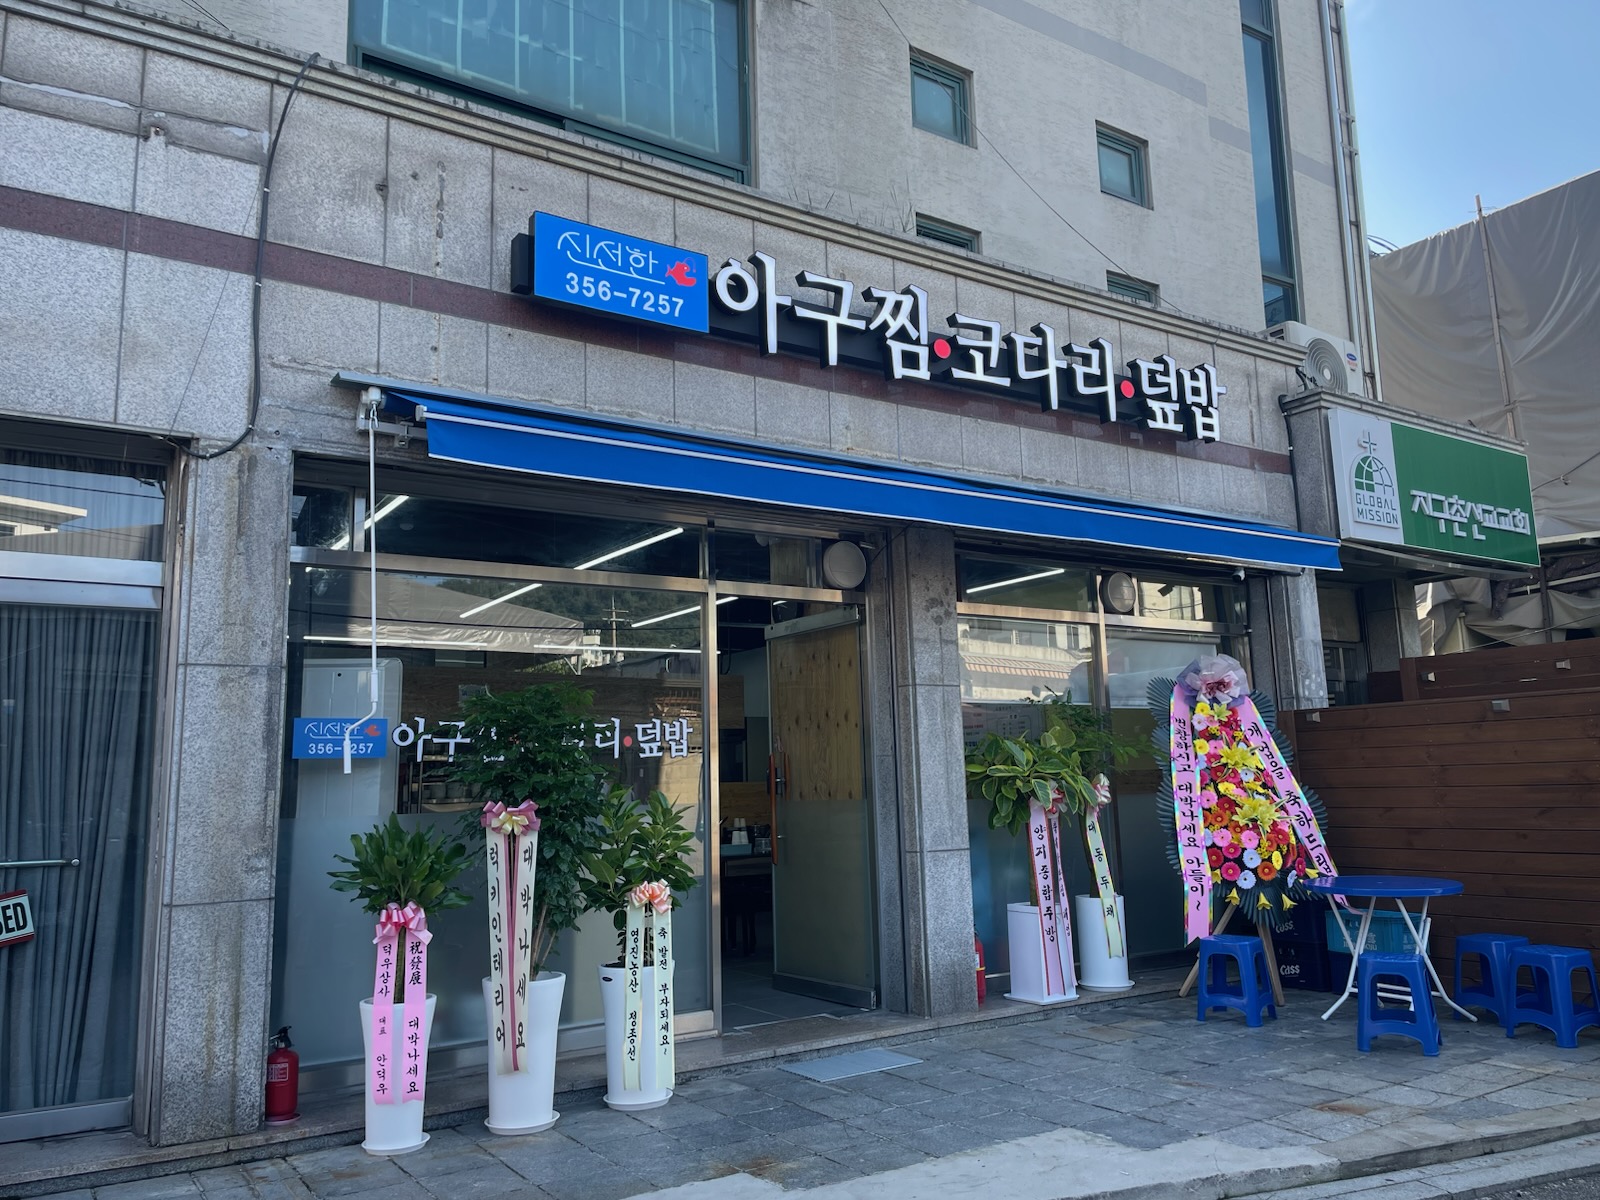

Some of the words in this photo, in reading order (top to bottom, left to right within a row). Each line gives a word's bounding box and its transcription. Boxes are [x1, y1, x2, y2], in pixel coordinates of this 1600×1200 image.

[557, 231, 666, 285] 신선한
[565, 272, 684, 318] 356-7257
[1355, 492, 1397, 511] GLOBAL
[1356, 507, 1399, 525] MISSION
[308, 743, 374, 755] 356-257
[1178, 781, 1201, 849] 대박나세요
[1033, 824, 1057, 943] 양지종합주방
[0, 901, 28, 936] ED
[408, 941, 423, 985] 祝發展
[489, 842, 506, 1052] 럭키인테리어
[515, 840, 534, 1050] 대박나세요
[628, 927, 639, 993] 영진농산
[378, 943, 393, 998] 덕우상사
[378, 1016, 387, 1036] 대표
[376, 1054, 388, 1096] 안덕우
[406, 1016, 420, 1094] 대박나세요
